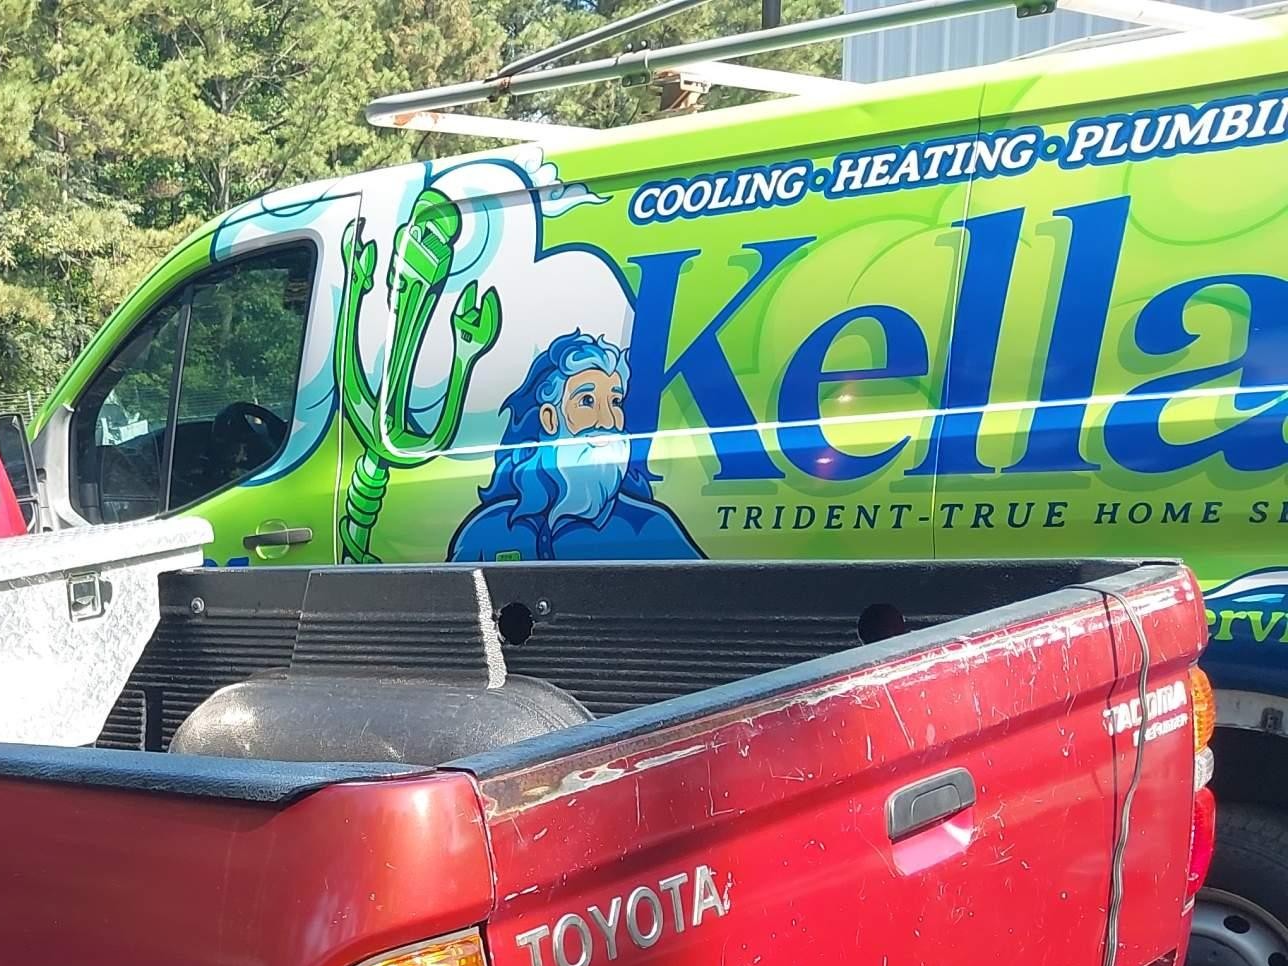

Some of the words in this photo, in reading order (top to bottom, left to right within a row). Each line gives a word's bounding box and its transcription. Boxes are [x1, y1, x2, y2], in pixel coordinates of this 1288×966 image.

[633, 166, 806, 220] COOLING
[831, 133, 1036, 193] HEATING
[717, 501, 1069, 530] TRIDENT-TRUE
[1094, 501, 1224, 525] HOME
